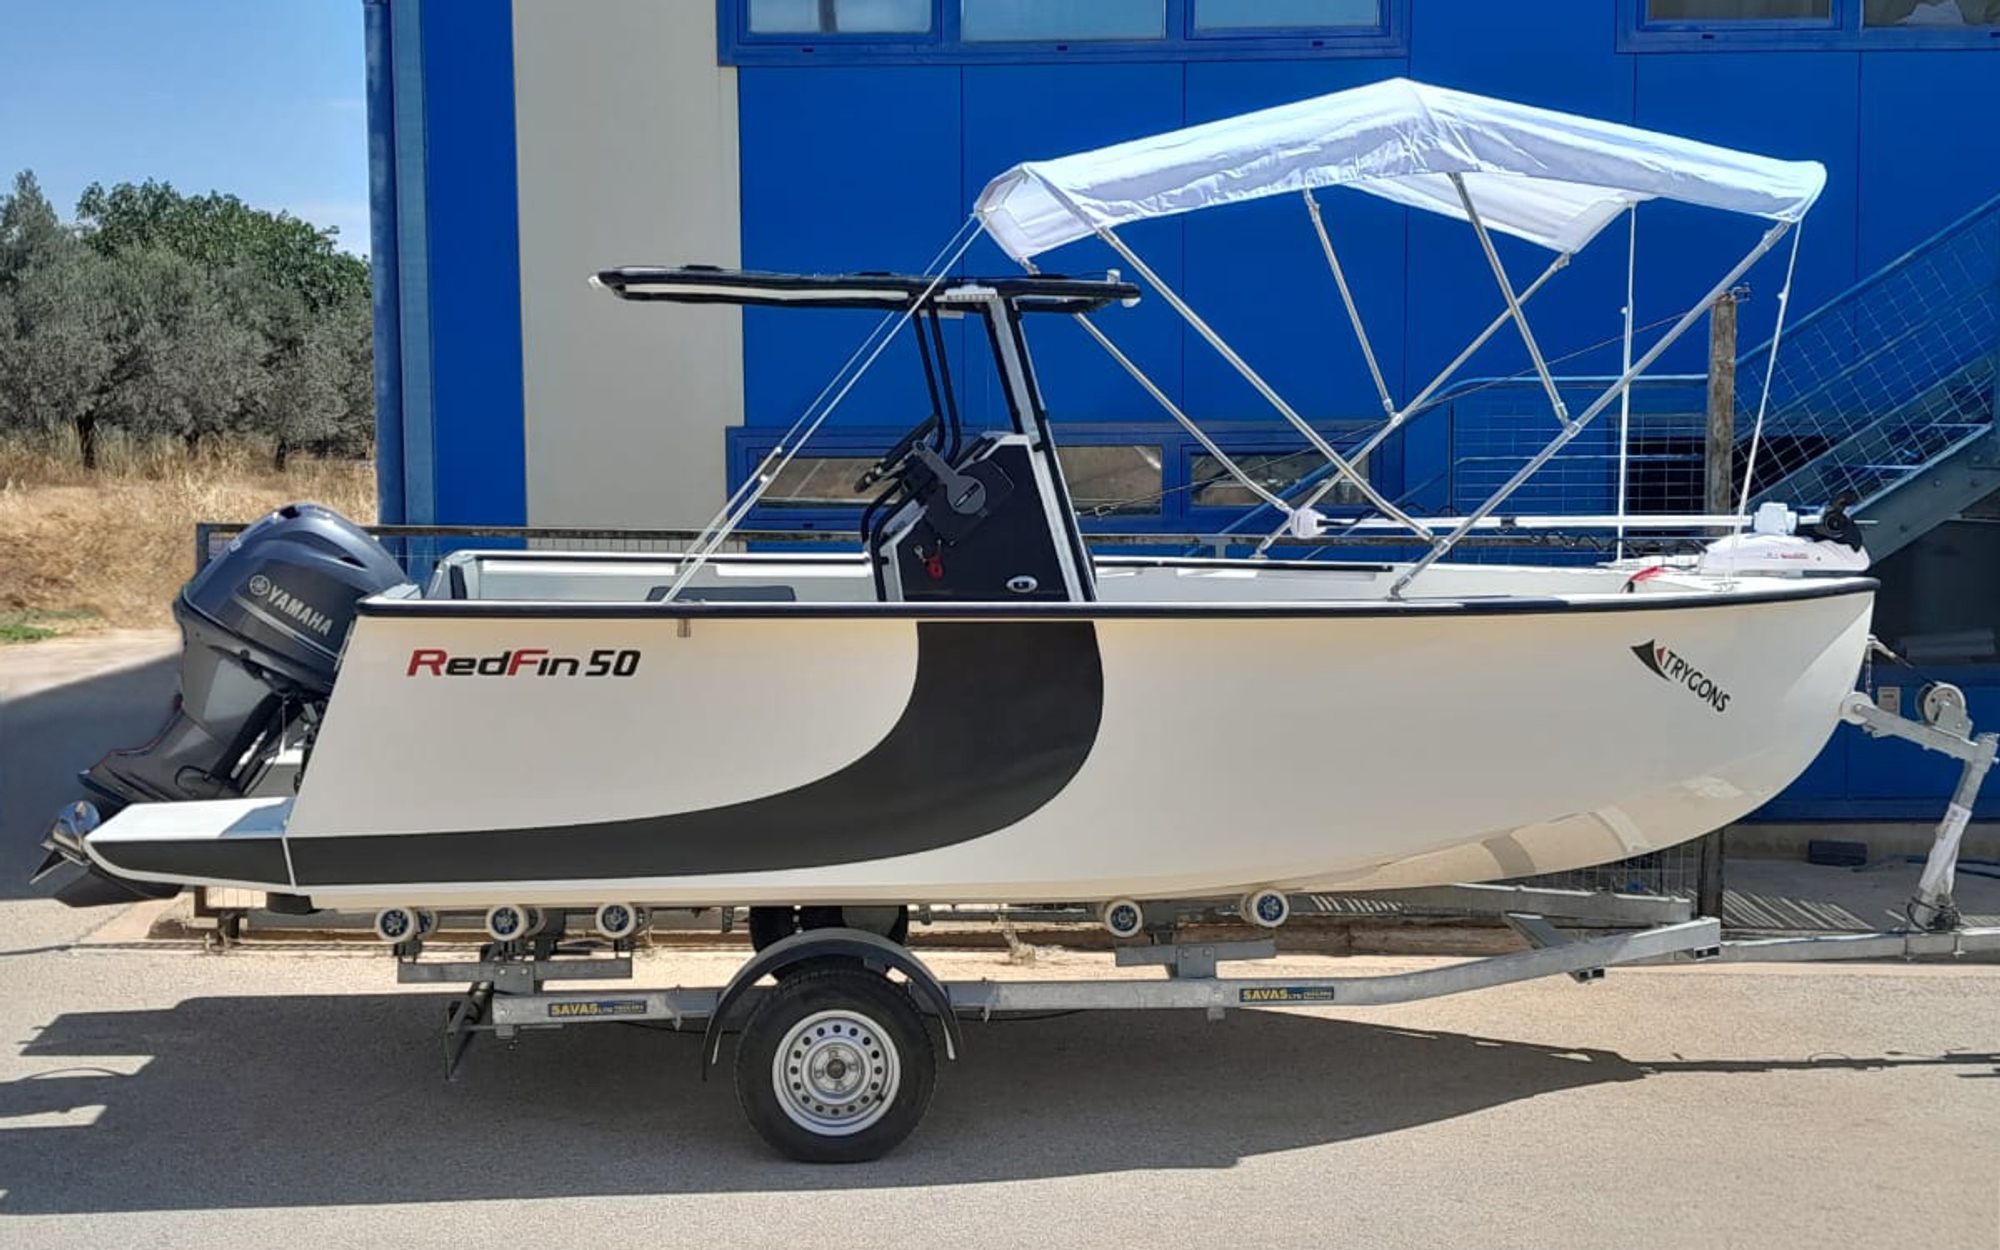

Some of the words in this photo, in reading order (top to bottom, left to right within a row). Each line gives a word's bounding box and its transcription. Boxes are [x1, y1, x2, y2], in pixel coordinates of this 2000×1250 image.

[268, 585, 333, 636] YAMAHA
[406, 649, 580, 677] RedFin
[585, 649, 642, 677] 50
[1243, 985, 1287, 1000] SAVAS
[551, 1003, 599, 1016] SAVAS
